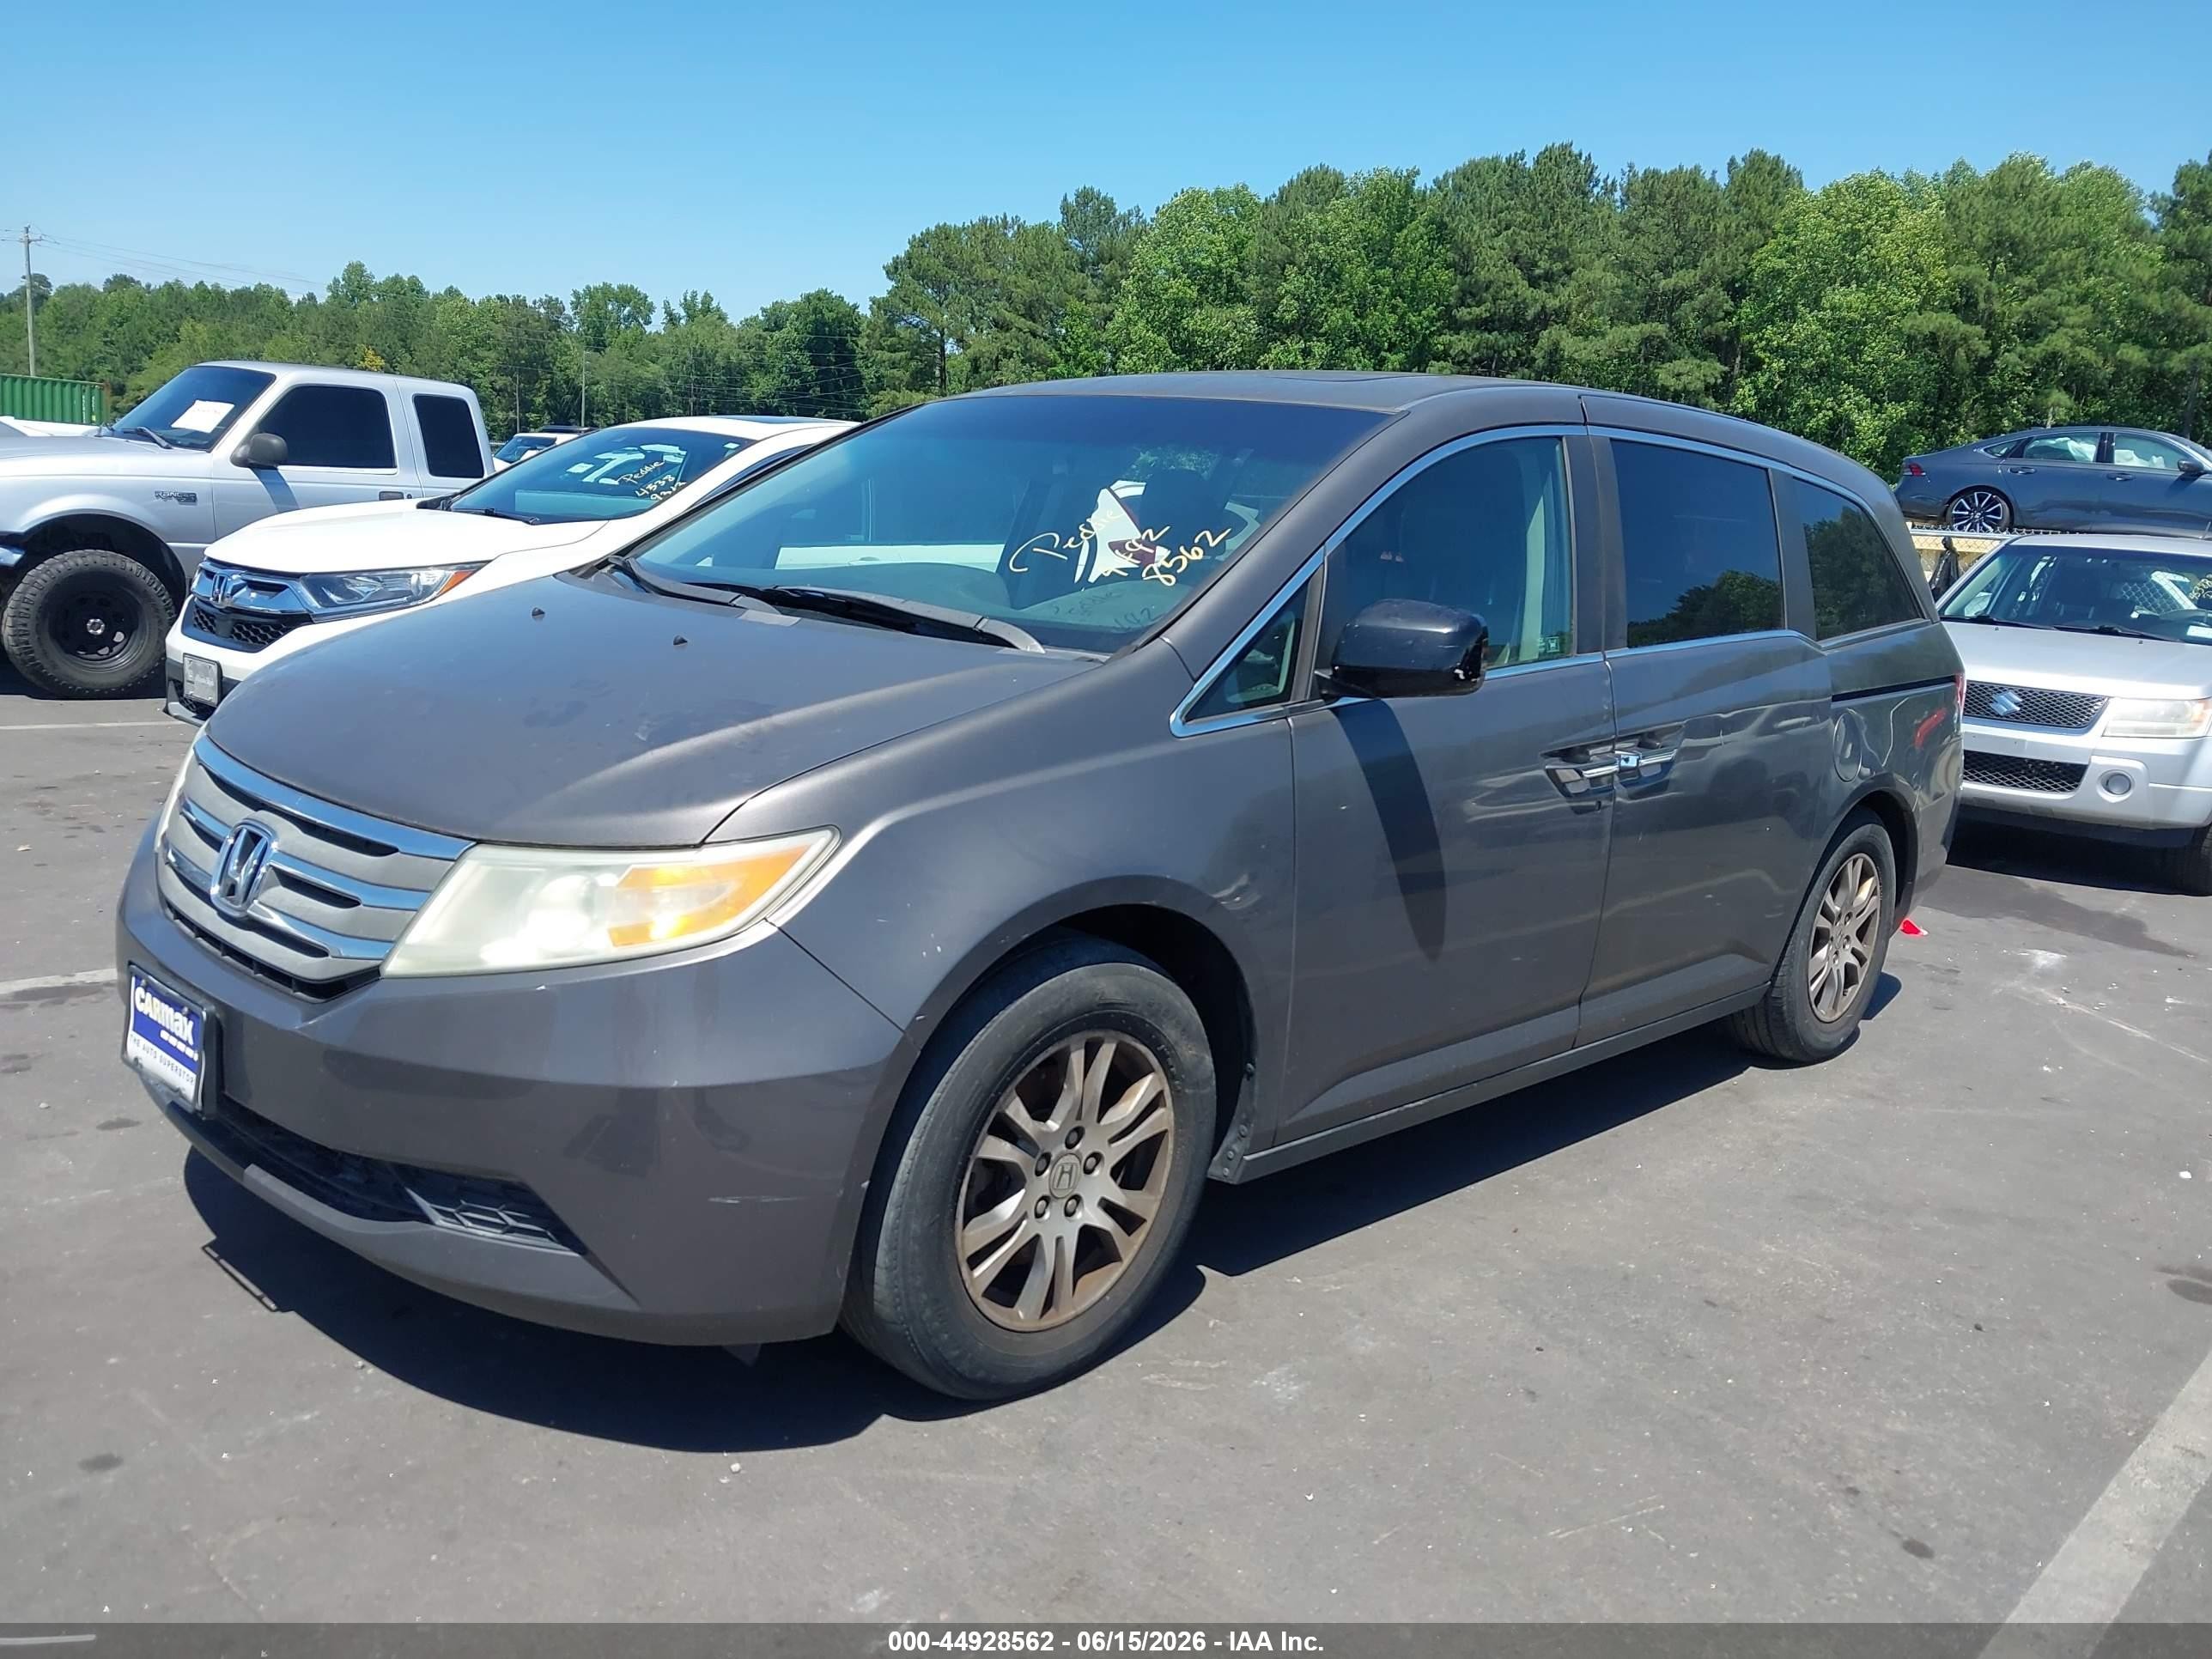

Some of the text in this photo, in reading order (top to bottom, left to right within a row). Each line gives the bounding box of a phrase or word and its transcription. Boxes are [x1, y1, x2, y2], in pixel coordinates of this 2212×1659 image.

[1141, 527, 1232, 587] 8562
[131, 1034, 194, 1085] THE AUTO SUPERSTOR
